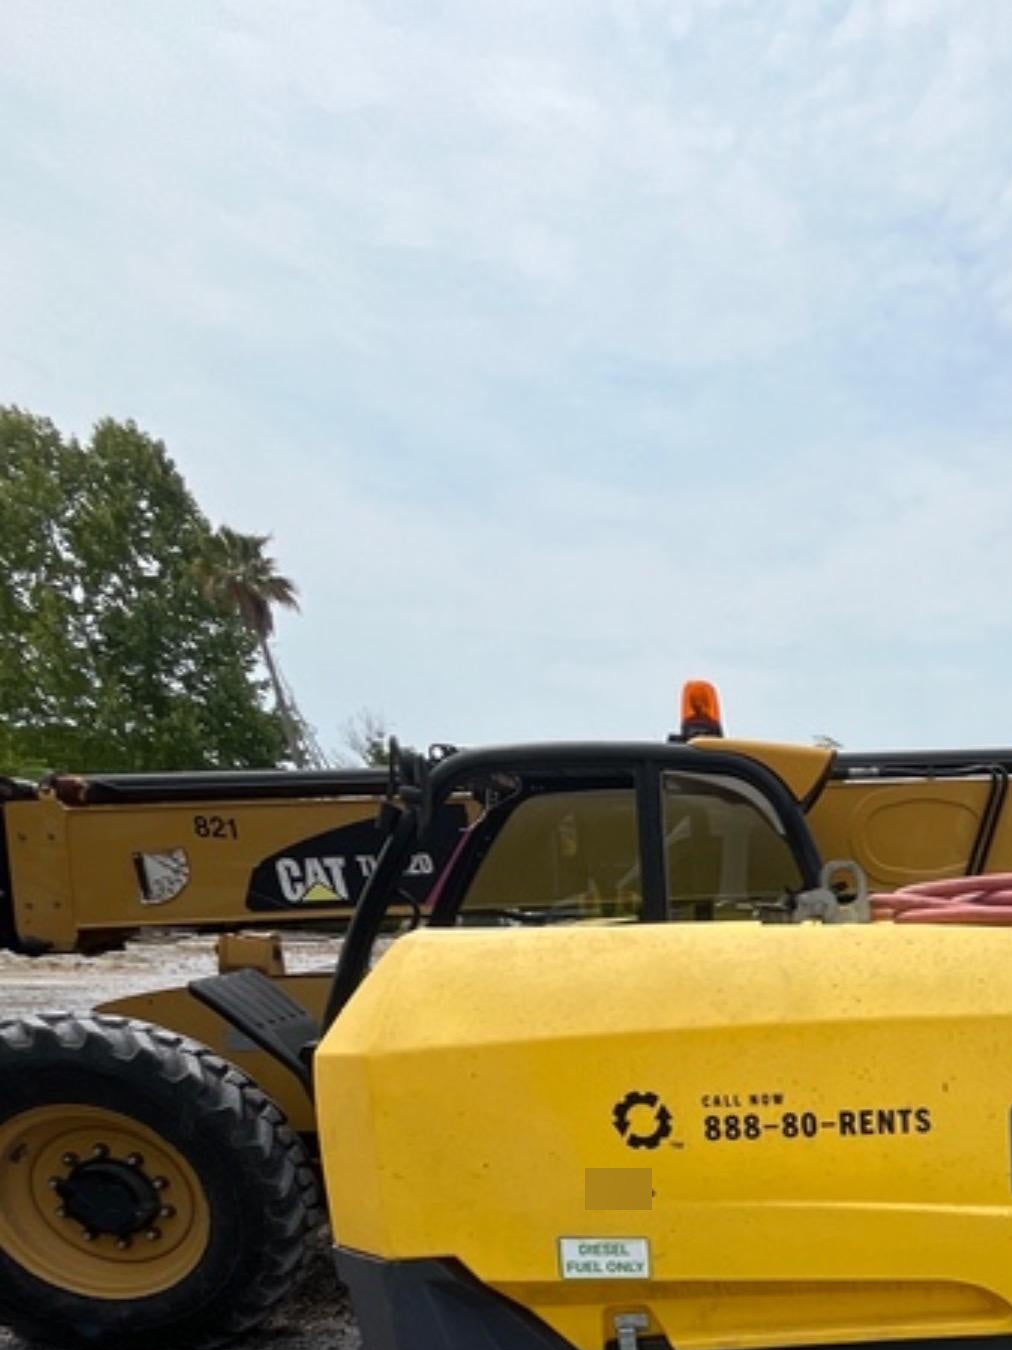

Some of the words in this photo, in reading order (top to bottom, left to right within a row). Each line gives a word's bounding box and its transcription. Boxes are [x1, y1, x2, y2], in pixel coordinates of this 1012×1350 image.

[194, 815, 238, 839] 821
[275, 856, 349, 903] CAT
[702, 1095, 742, 1107] CALL
[750, 1094, 784, 1105] NOW
[705, 1108, 931, 1140] 888-80-RENTS
[578, 1244, 630, 1256] DIESEL
[566, 1262, 603, 1273] FUEL
[606, 1261, 644, 1273] ONLY
